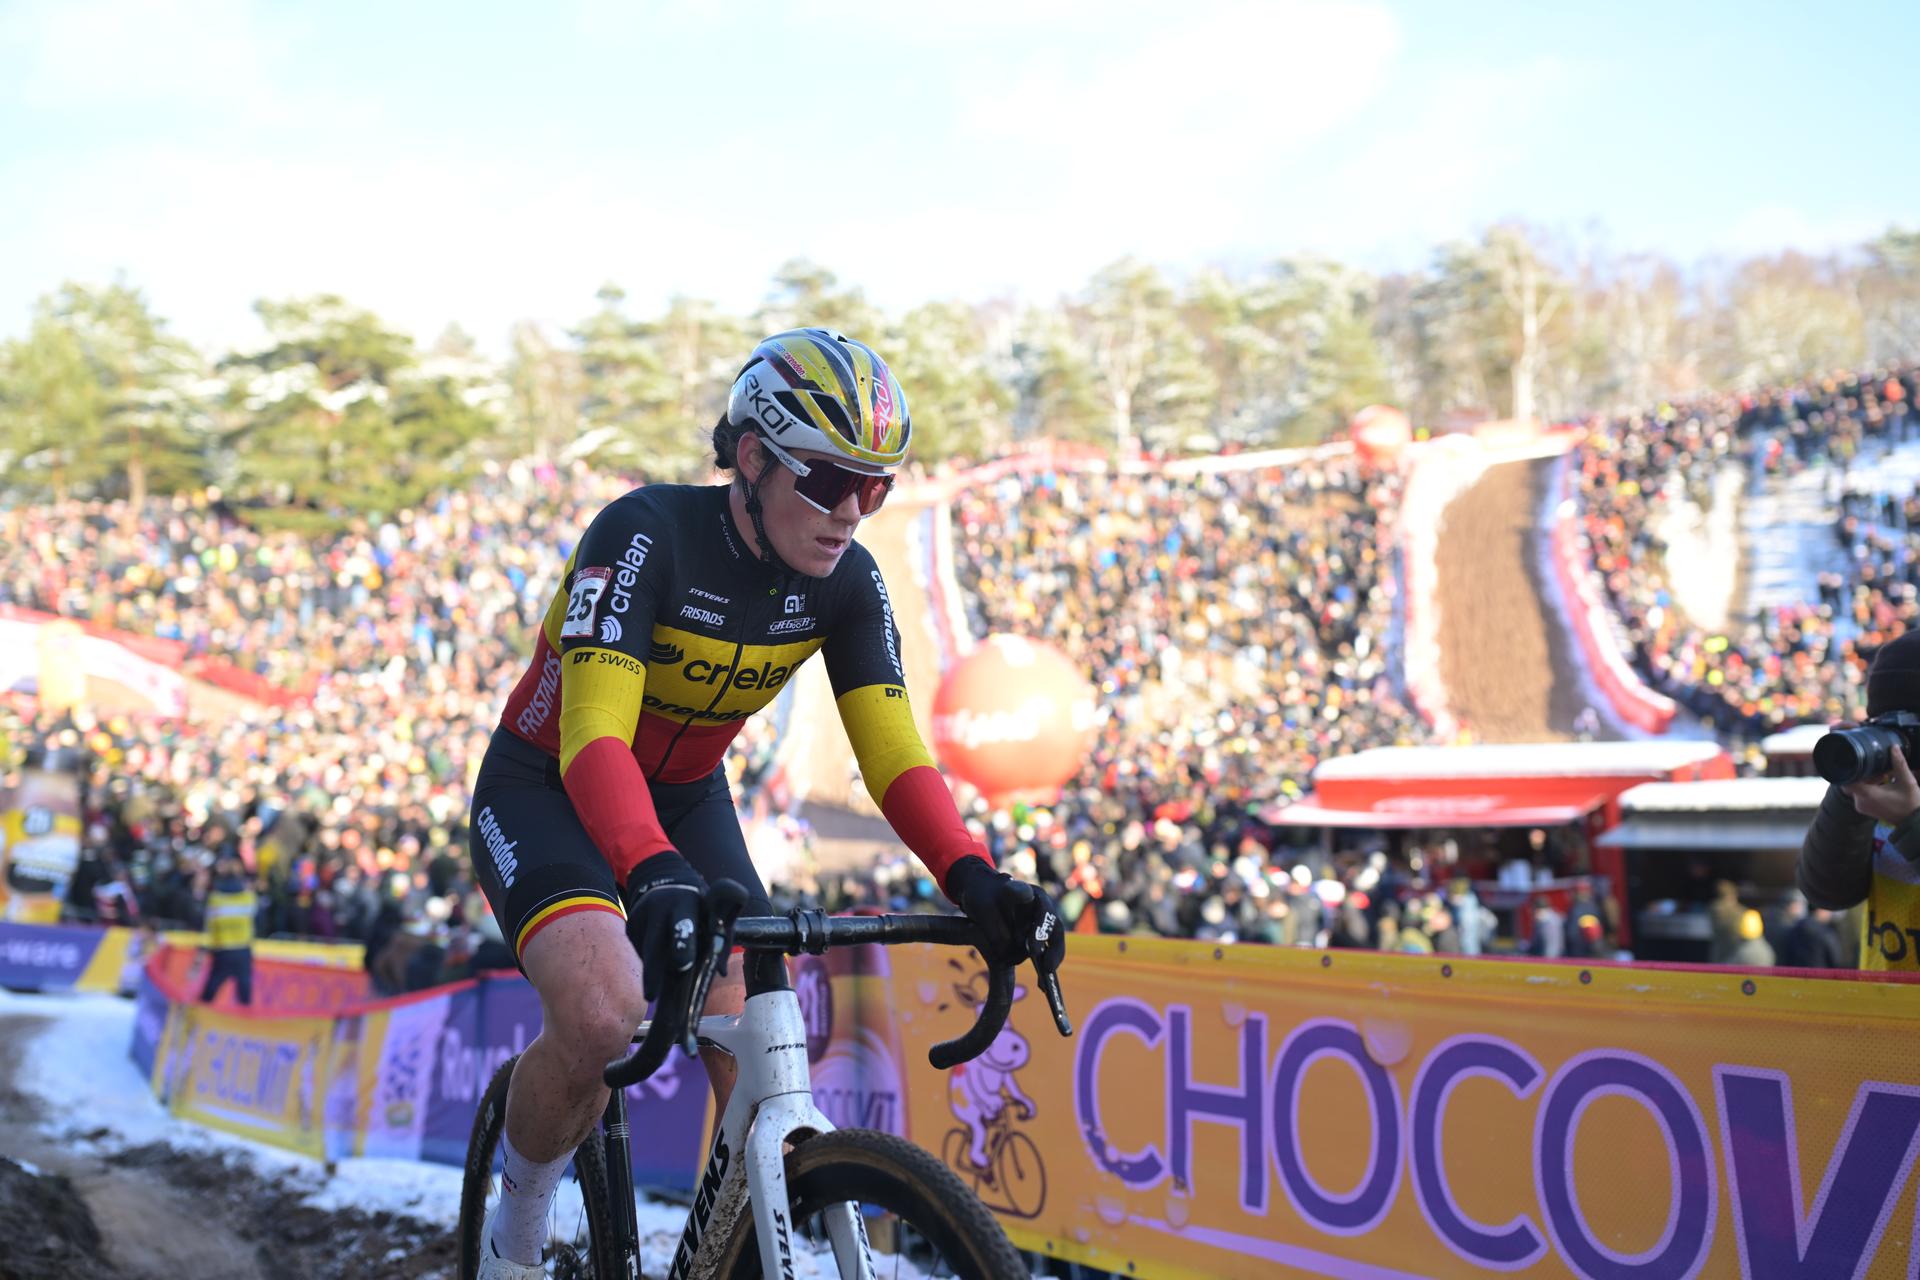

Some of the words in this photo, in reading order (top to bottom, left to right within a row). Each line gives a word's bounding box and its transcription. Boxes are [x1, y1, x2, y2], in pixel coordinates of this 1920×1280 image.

[611, 533, 653, 614] crelan
[566, 588, 597, 622] 25
[688, 587, 731, 605] STEVENS
[679, 605, 726, 626] FRISTADS
[573, 652, 596, 664] DT
[598, 652, 641, 675] SWISS
[516, 650, 562, 741] FRISTADS
[885, 687, 903, 699] DT
[643, 695, 755, 722] orendo
[1074, 994, 1920, 1280] CHOCOV
